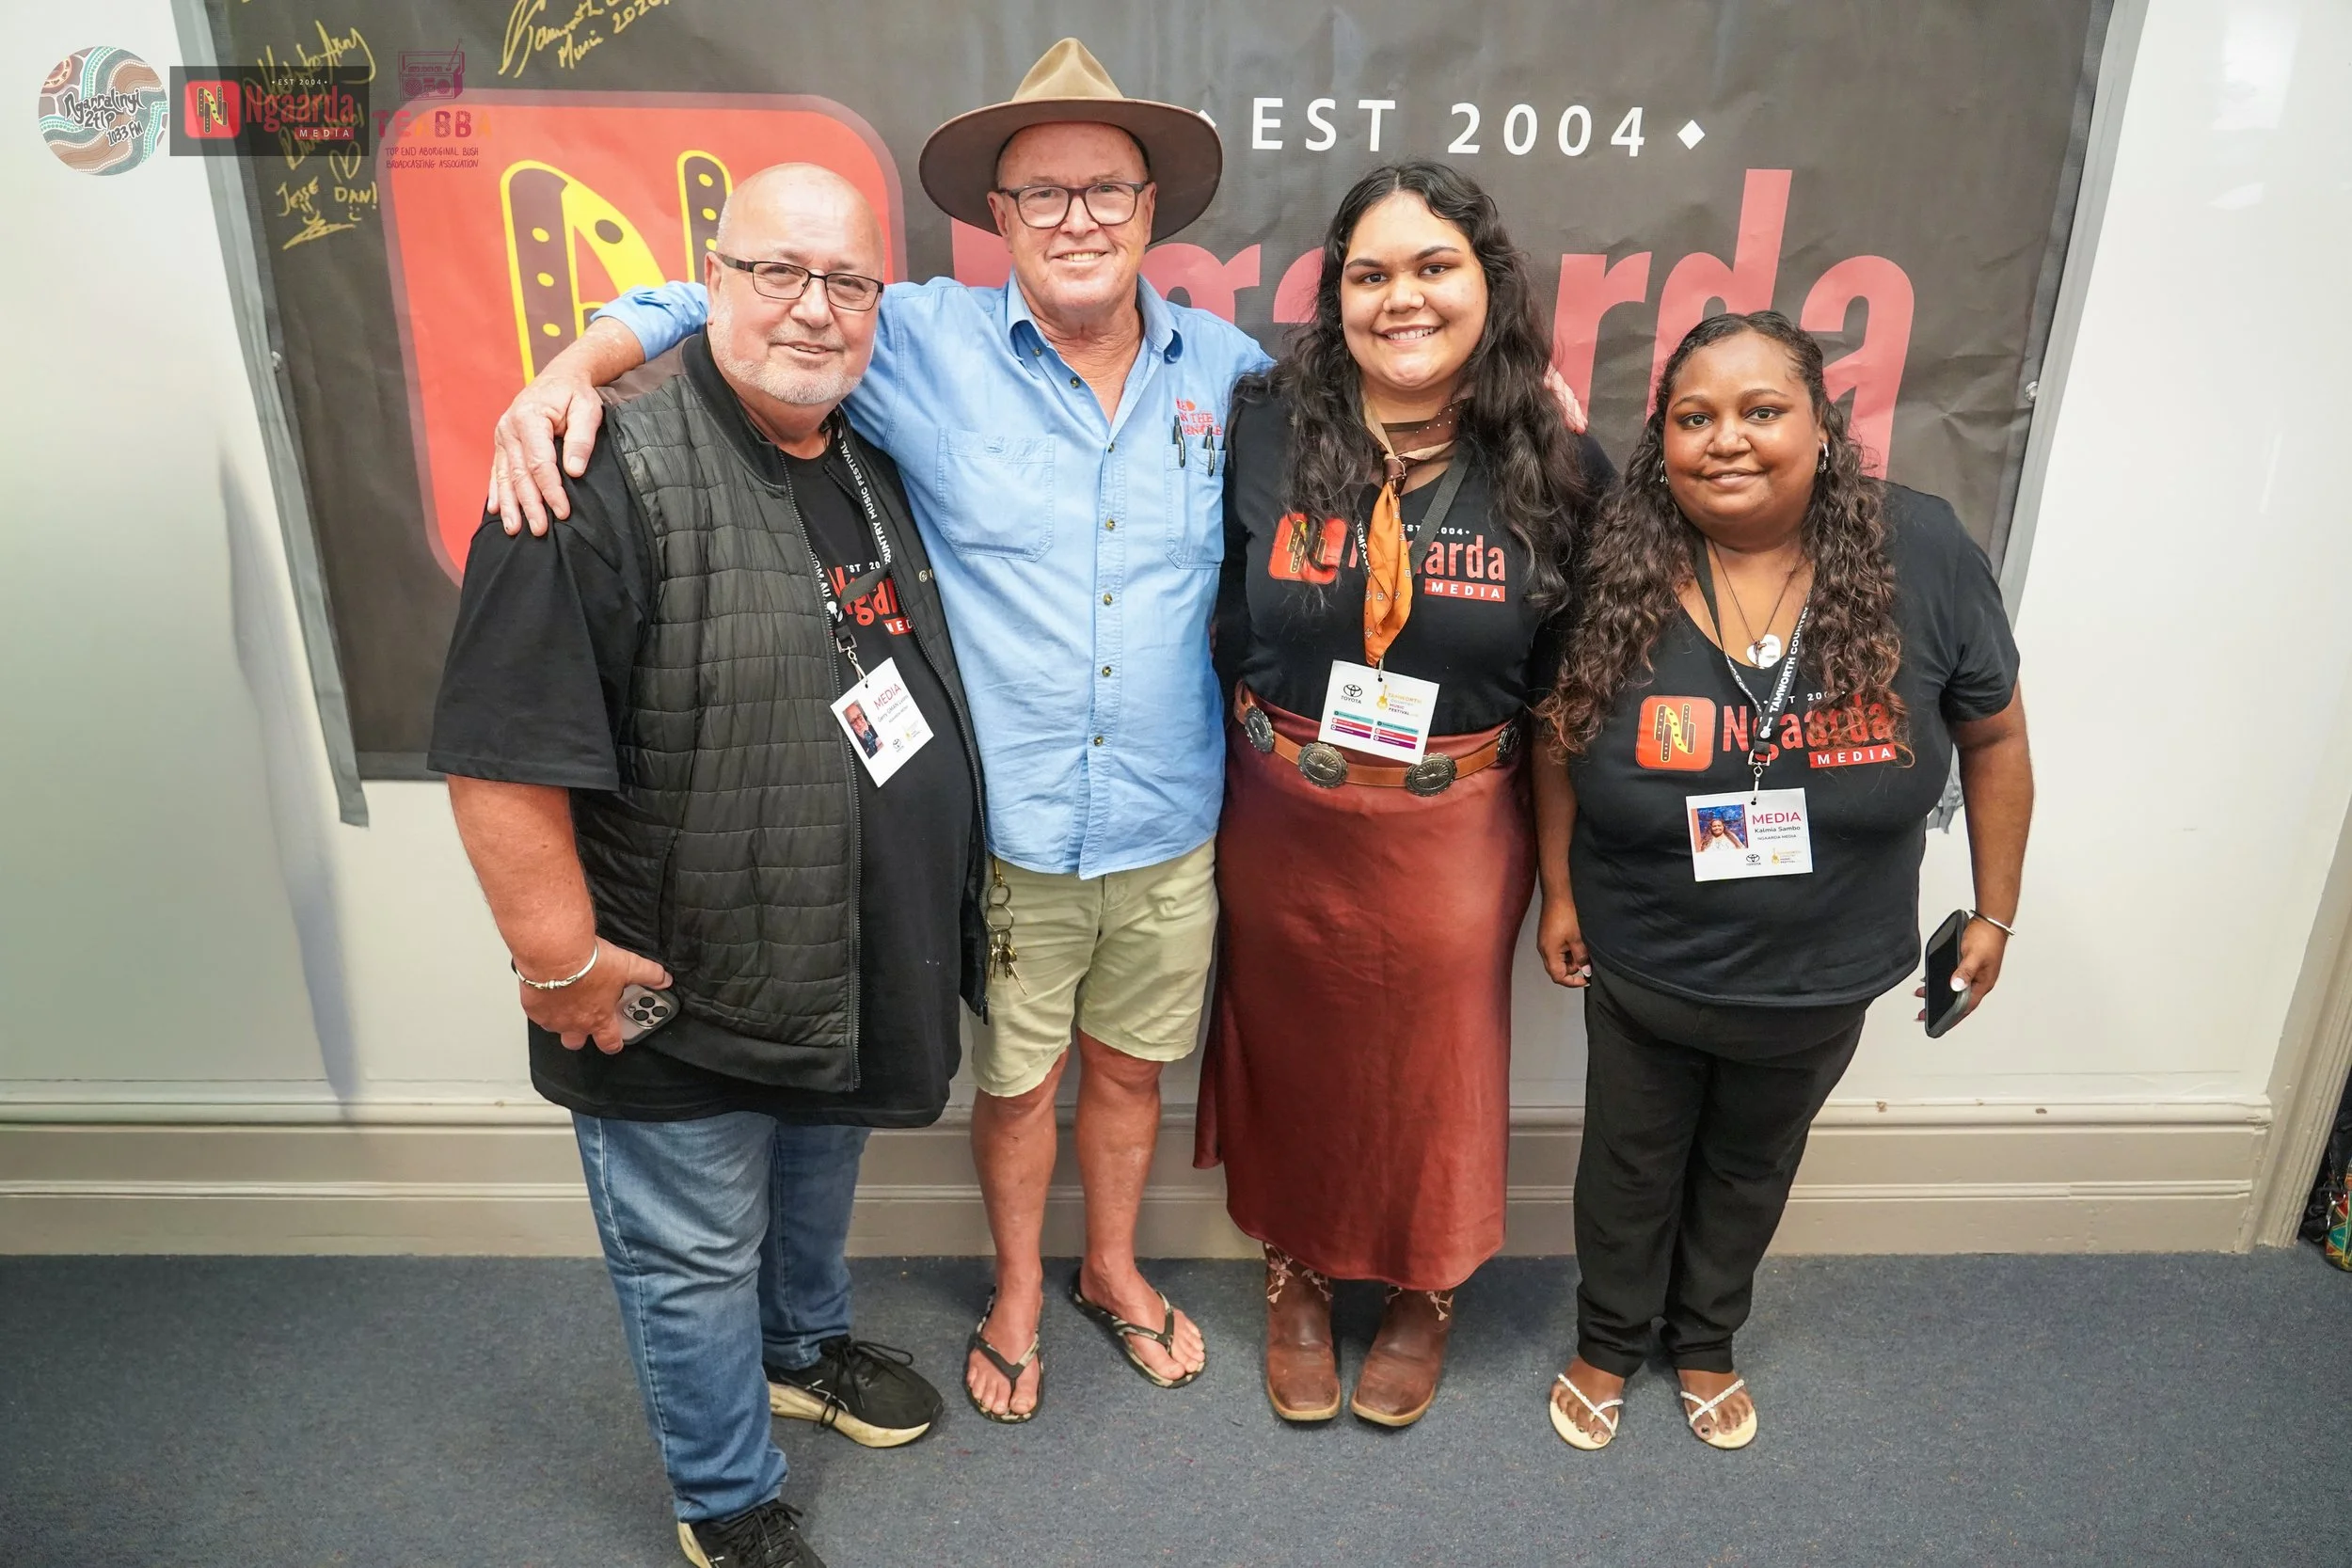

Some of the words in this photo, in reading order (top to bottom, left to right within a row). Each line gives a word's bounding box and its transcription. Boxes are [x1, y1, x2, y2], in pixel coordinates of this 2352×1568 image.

[1251, 97, 1396, 152] EST
[1447, 102, 1645, 158] 2004
[840, 440, 866, 487] FESTIVAL
[861, 486, 878, 520] MUSIC
[1431, 581, 1501, 599] MEDIA
[873, 683, 902, 710] MEDIA
[1769, 657, 1796, 713] TAMWORTH
[1341, 695, 1362, 705] TOYOTA
[1817, 747, 1892, 766] MEDIA
[1752, 811, 1802, 825] MEDIA
